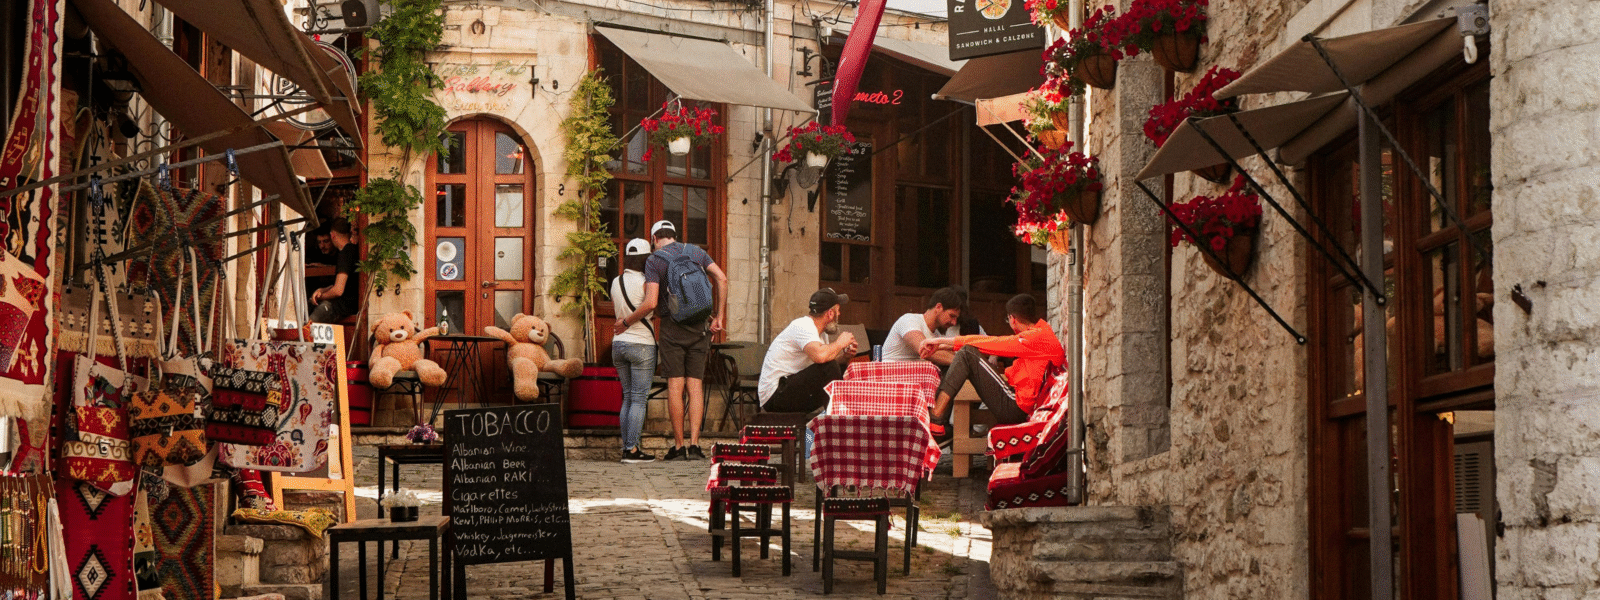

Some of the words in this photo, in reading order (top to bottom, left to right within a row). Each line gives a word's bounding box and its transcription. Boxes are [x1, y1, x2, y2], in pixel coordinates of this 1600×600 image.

[983, 25, 1005, 33] HALAL
[956, 39, 993, 49] SANDWICH
[1002, 32, 1035, 42] CALZONE
[891, 89, 904, 105] 2
[455, 409, 550, 437] TOBACCO
[452, 442, 495, 457] Albanian
[451, 457, 496, 473] Albanian
[453, 472, 497, 485] Albanian
[452, 487, 519, 508] Cigarettes
